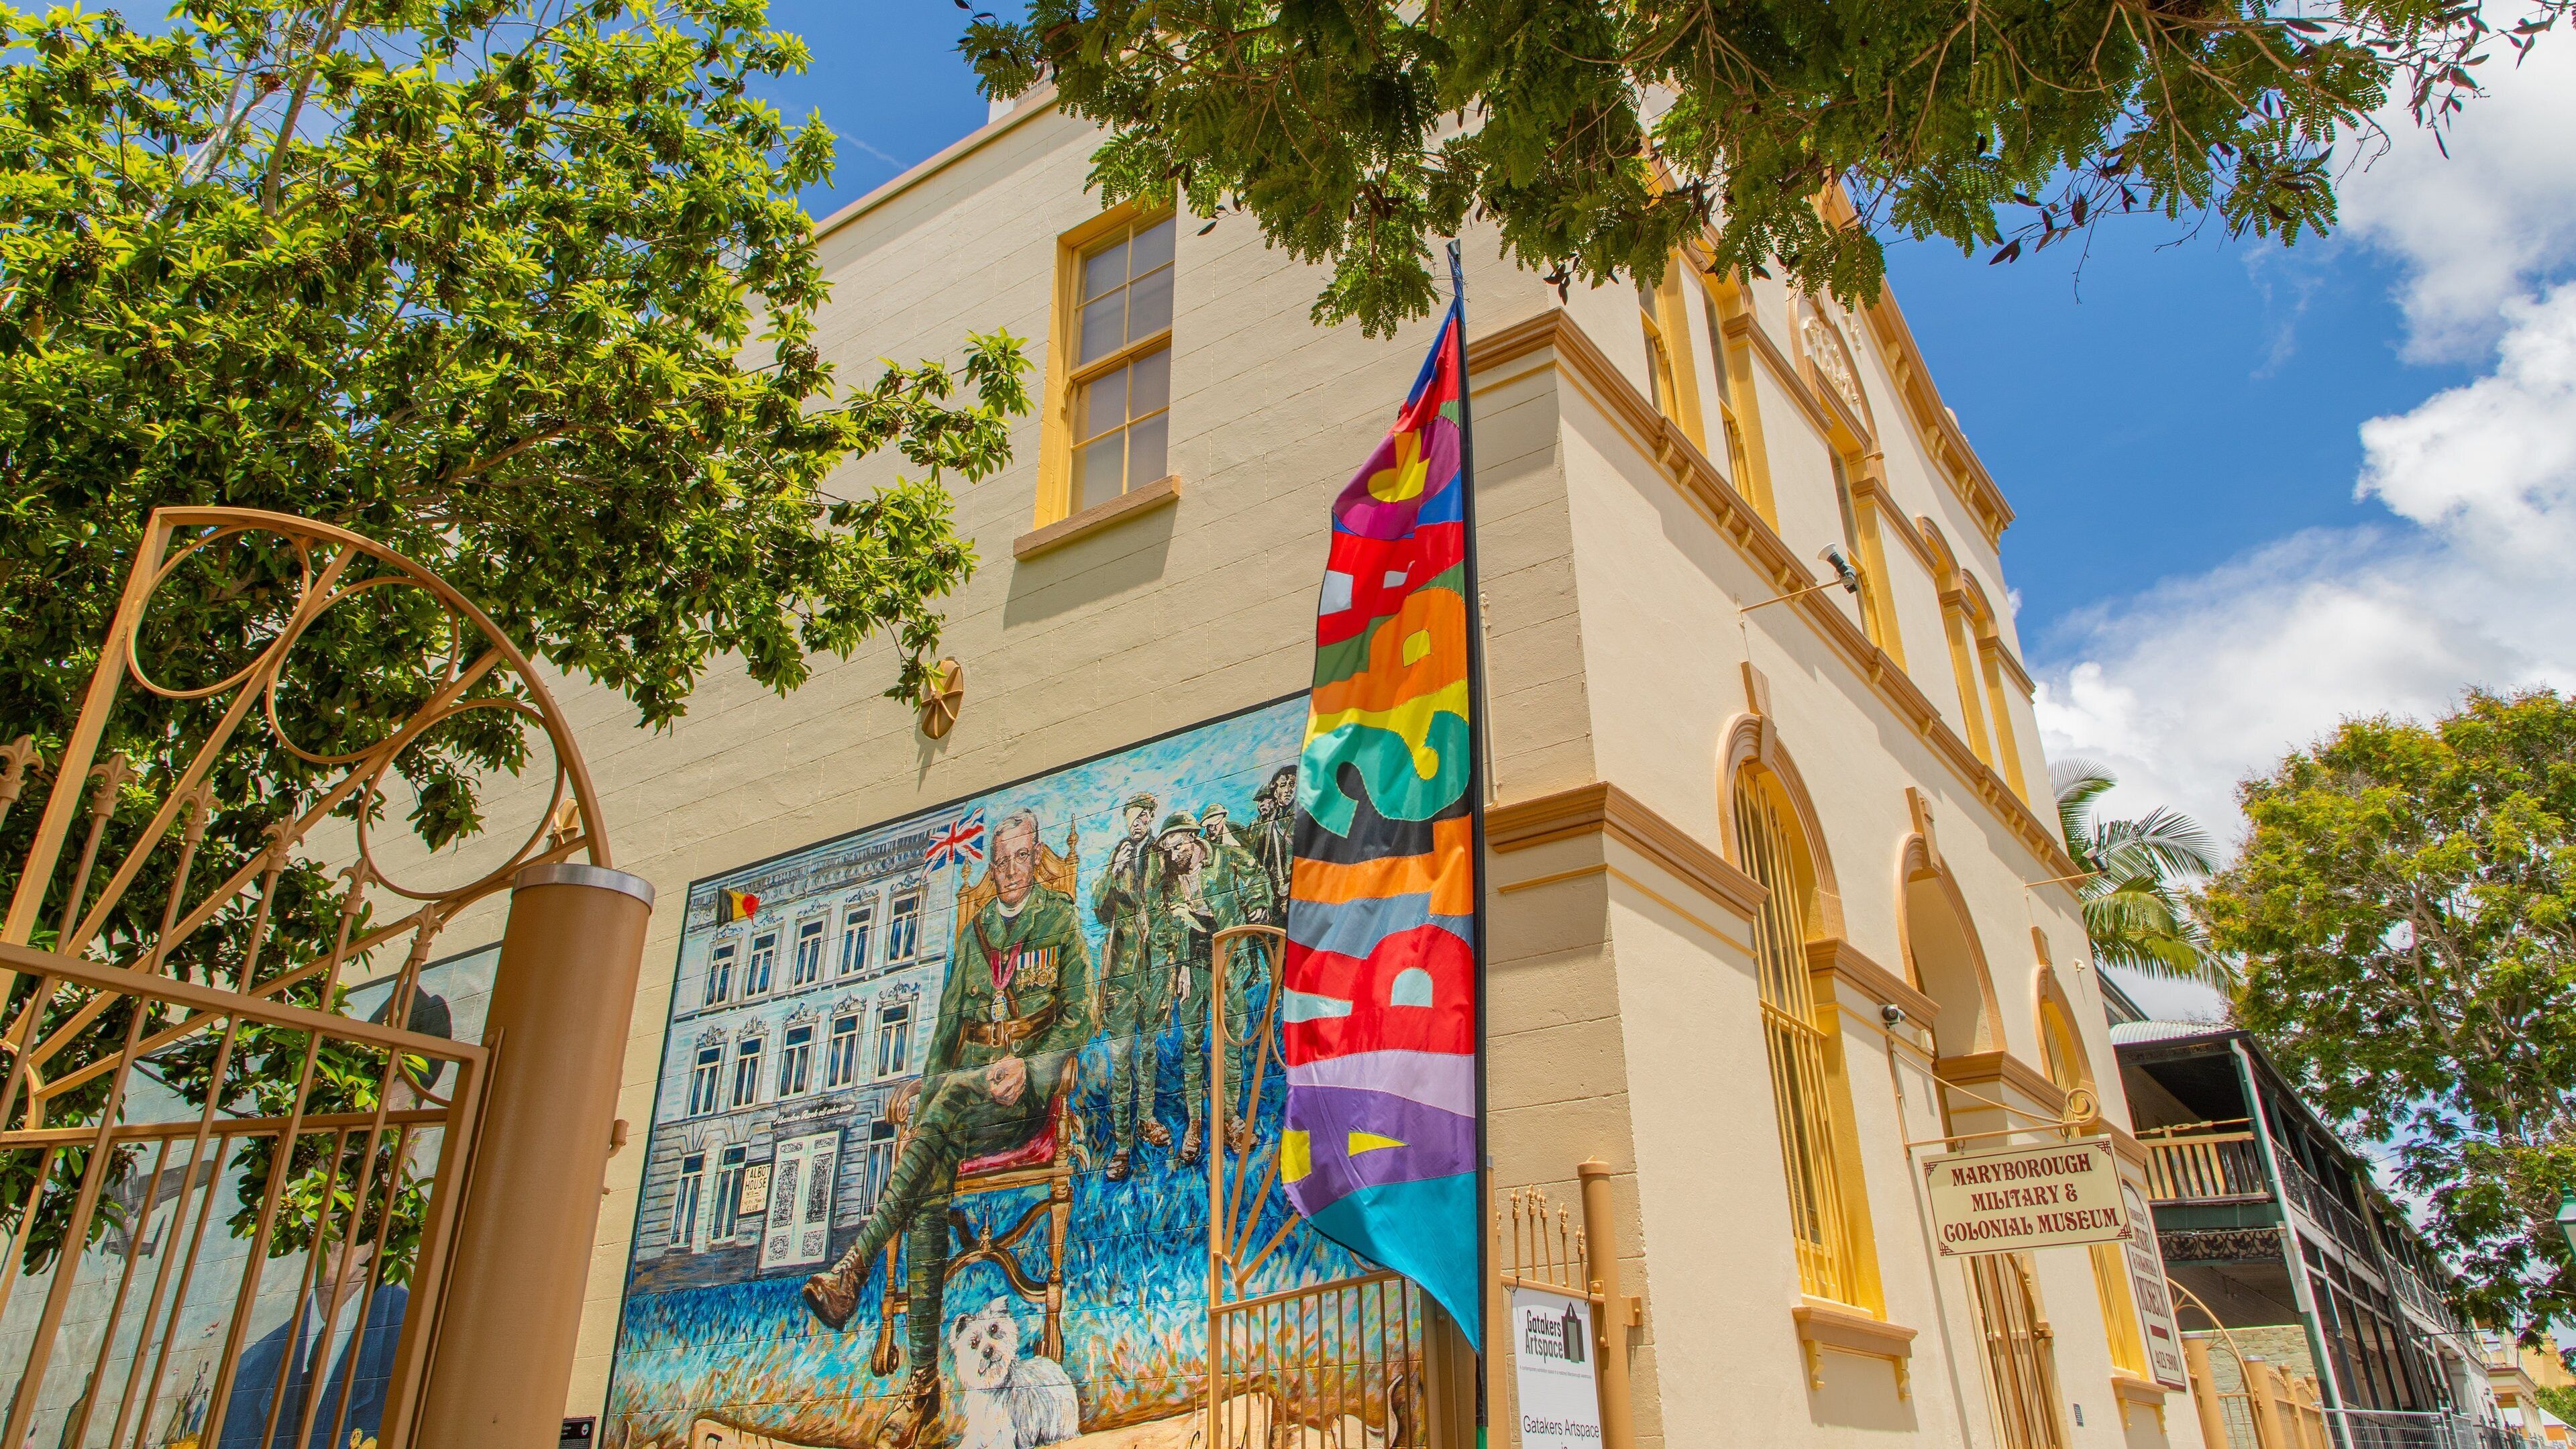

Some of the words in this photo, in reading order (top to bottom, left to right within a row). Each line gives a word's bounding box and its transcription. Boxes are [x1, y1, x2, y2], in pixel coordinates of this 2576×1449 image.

[745, 1177, 767, 1191] HOUSE
[746, 1165, 771, 1179] TALBOT
[1951, 1152, 2092, 1187] MARYBOROUGH
[1970, 1185, 2059, 1212] MILITARY
[2065, 1183, 2078, 1203] &
[1943, 1216, 2034, 1242] COLONIAL
[2036, 1208, 2121, 1234] MUSEUM
[1526, 1309, 1562, 1338] Gatakers
[1525, 1328, 1564, 1364] Artspace
[1523, 1415, 1563, 1436] Gatakers
[1564, 1419, 1600, 1441] Artspace
